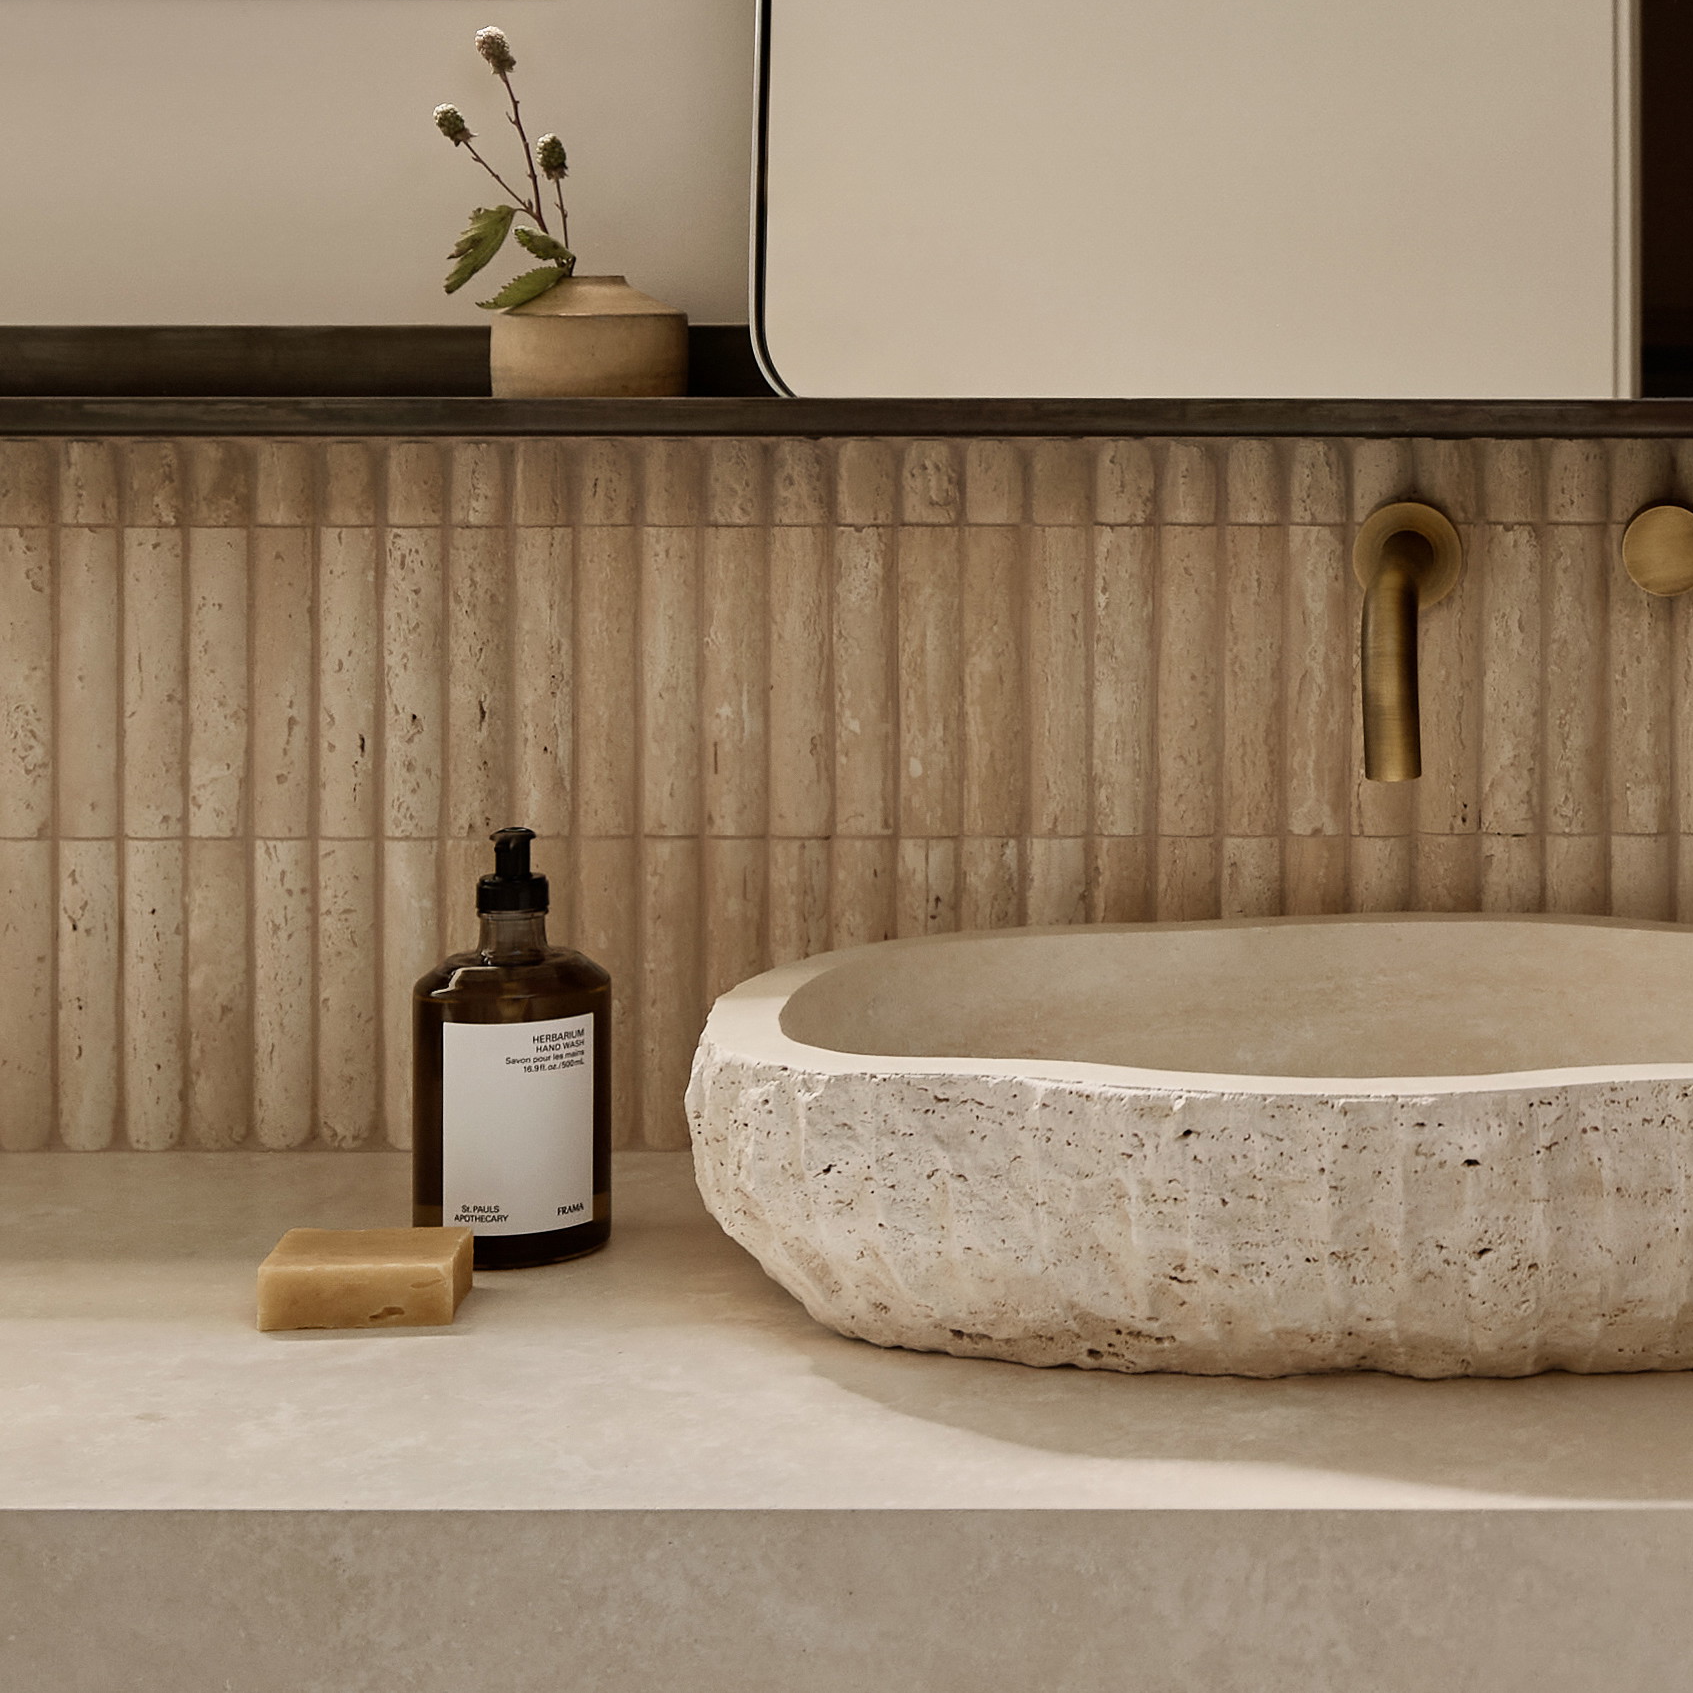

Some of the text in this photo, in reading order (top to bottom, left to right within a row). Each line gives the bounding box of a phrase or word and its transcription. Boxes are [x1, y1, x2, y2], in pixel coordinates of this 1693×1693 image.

[532, 1028, 585, 1044] HERBARIUM
[536, 1039, 585, 1053] HAND WASH
[505, 1057, 531, 1065] Savon
[532, 1055, 551, 1064] pour
[472, 1205, 500, 1214] PAULS
[556, 1202, 584, 1216] FRAMA
[454, 1214, 509, 1223] APOTHECARY
